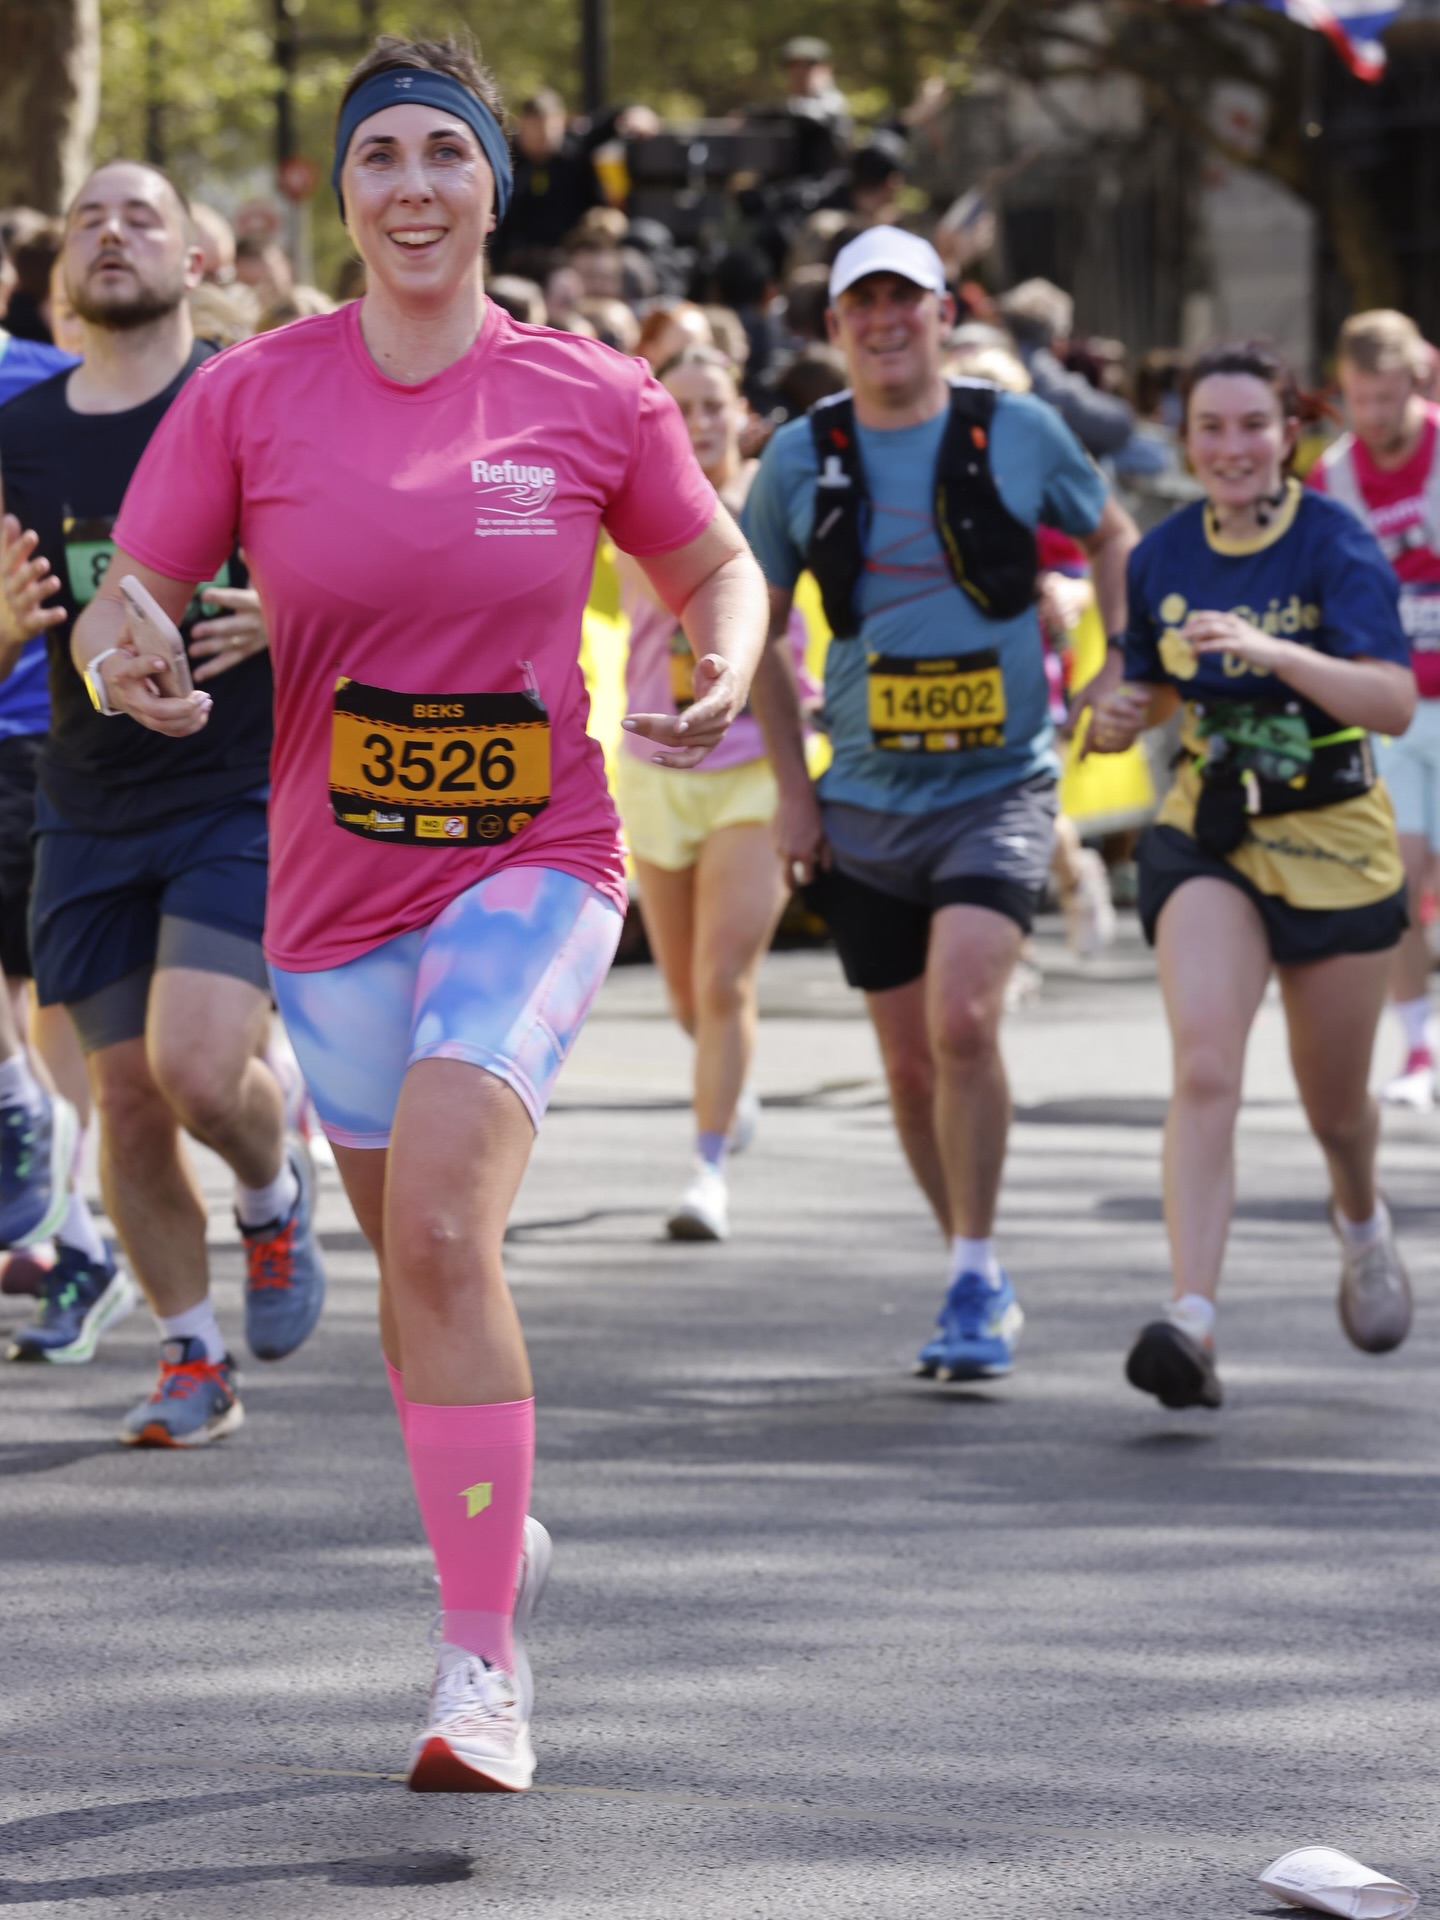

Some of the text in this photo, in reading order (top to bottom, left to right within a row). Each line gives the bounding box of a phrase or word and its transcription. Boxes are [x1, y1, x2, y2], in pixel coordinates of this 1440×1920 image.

[471, 459, 556, 488] Refuge
[412, 703, 465, 718] BEKS
[880, 681, 995, 719] 14602
[361, 734, 516, 792] 3526
